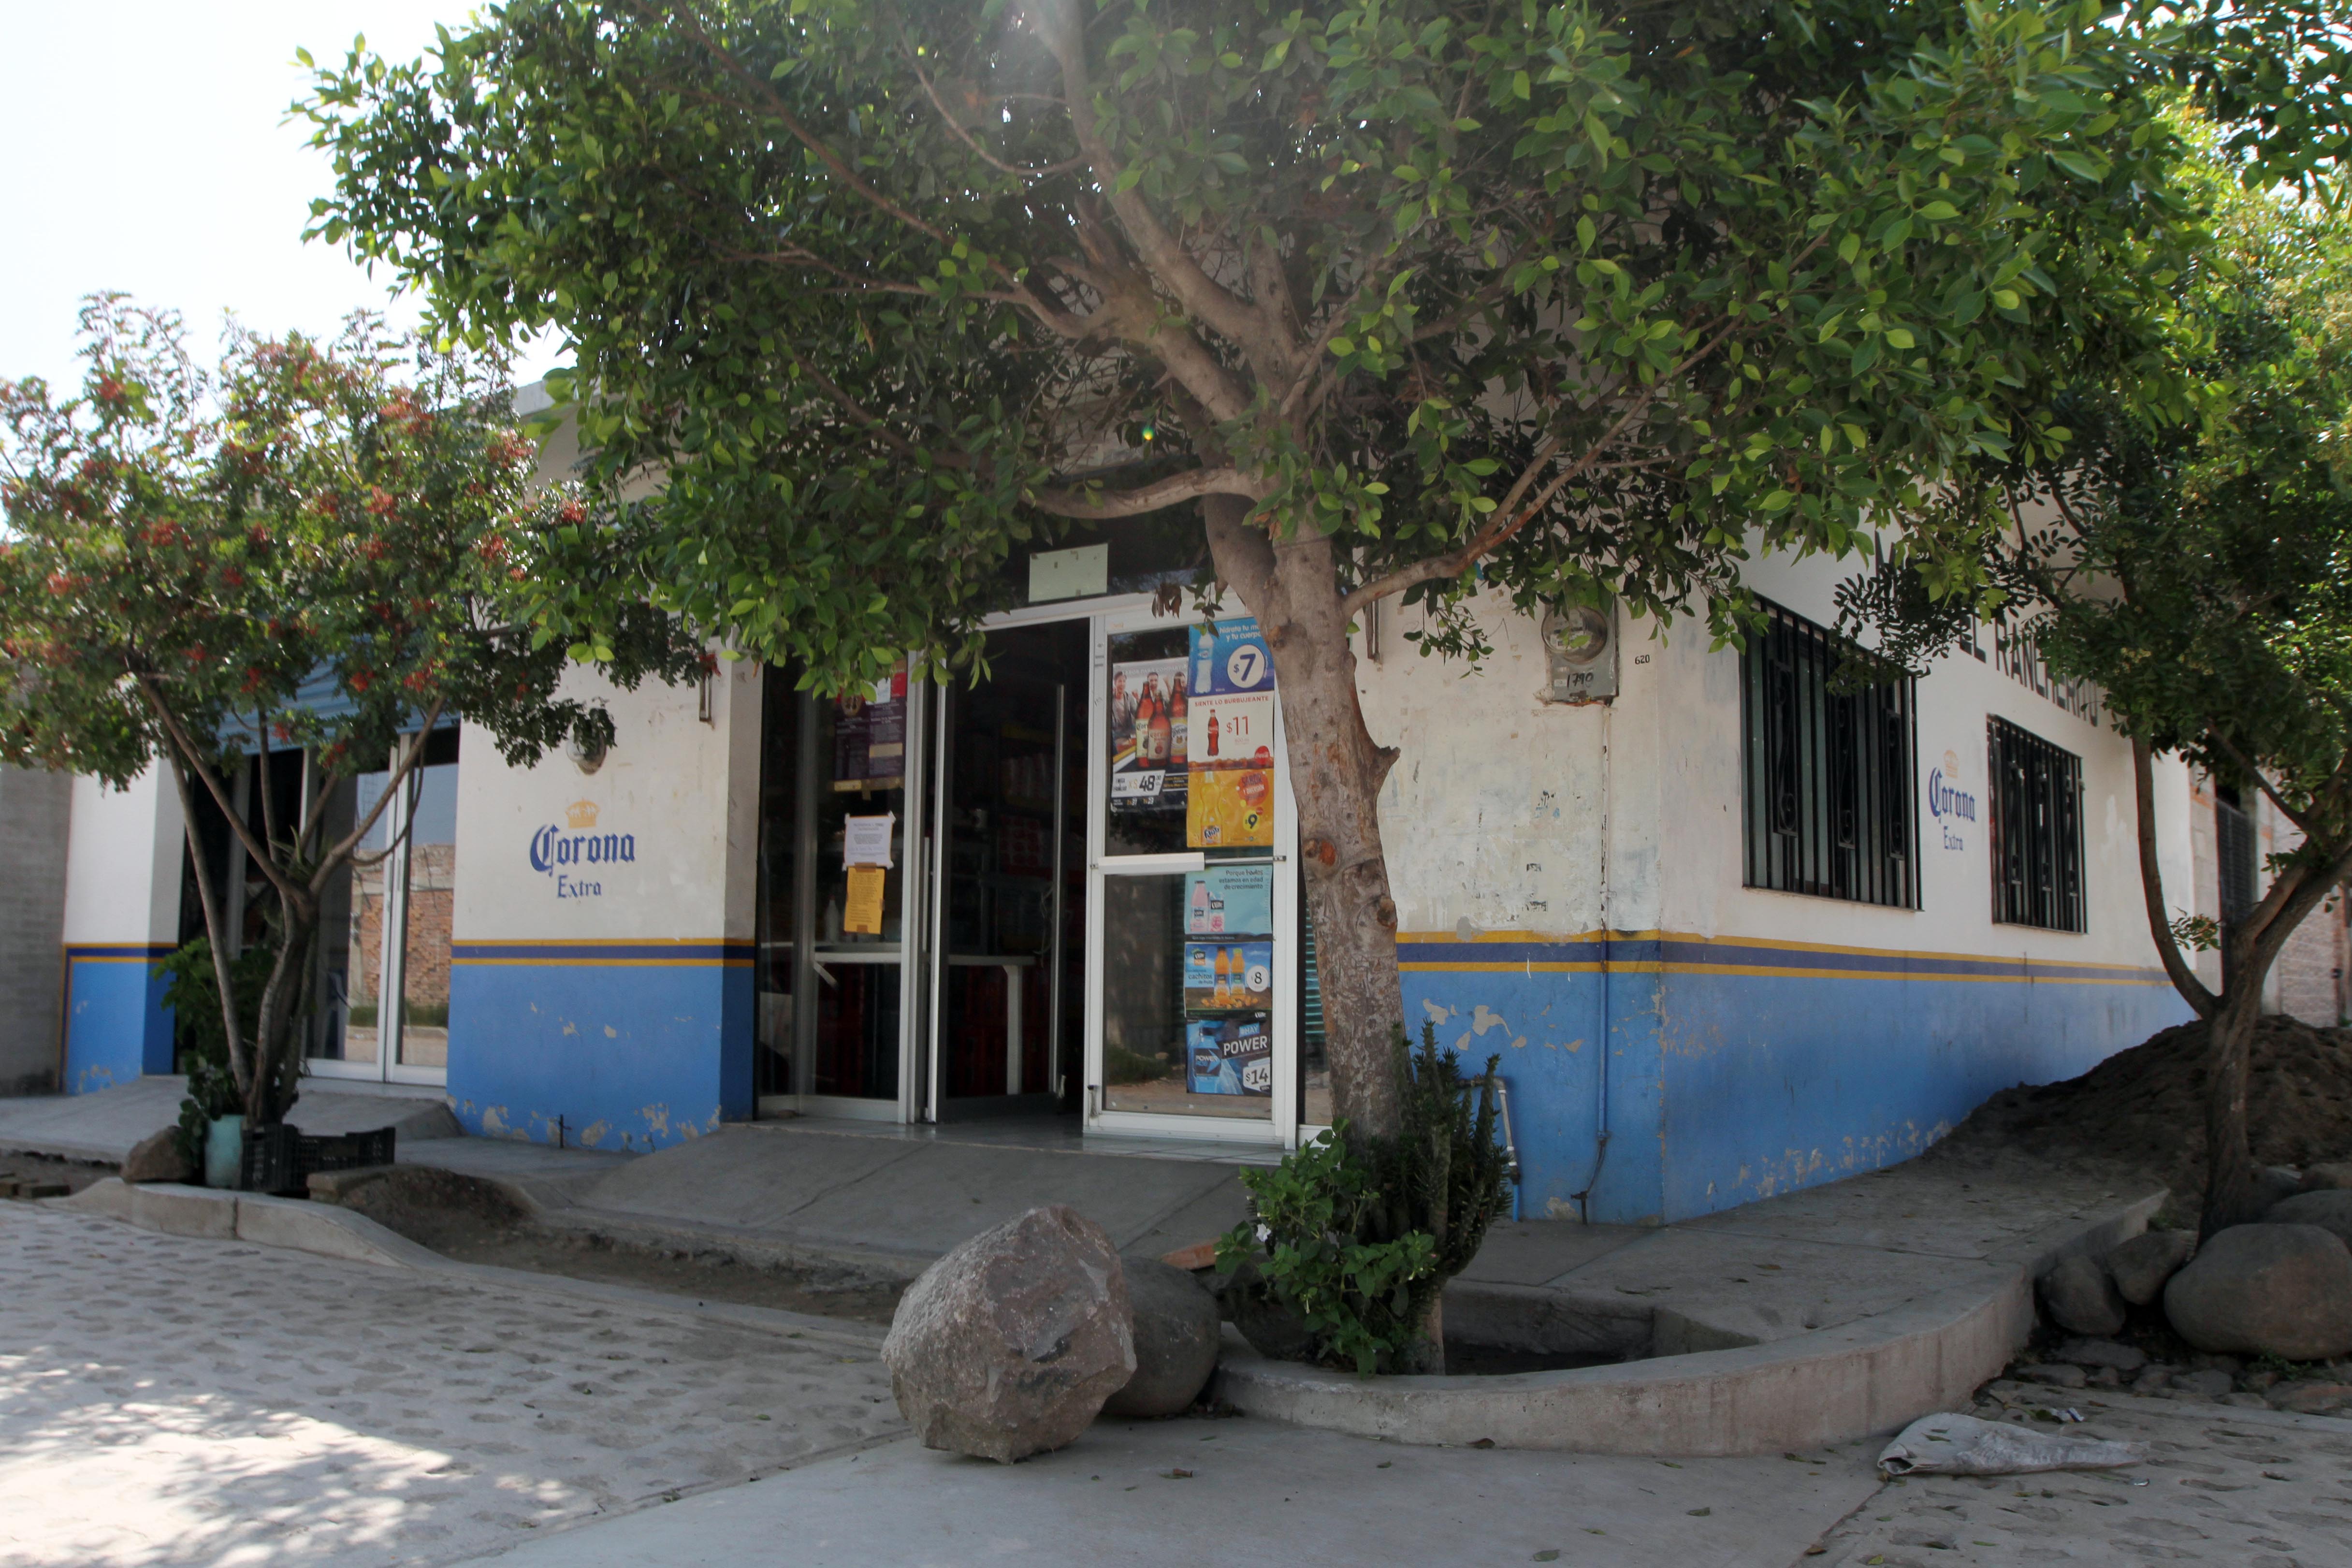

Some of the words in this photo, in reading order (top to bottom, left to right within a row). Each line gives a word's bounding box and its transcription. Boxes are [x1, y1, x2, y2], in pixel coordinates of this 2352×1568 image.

[1226, 634, 1231, 642] y
[1234, 653, 1256, 682] $7
[1635, 654, 1650, 665] 620
[1224, 696, 1269, 704] BURBUJEANTE
[1226, 715, 1249, 735] $11
[1929, 767, 1976, 823] Corona
[1943, 826, 1963, 851] Extra
[530, 823, 636, 876] Corona
[557, 875, 602, 898] Extra
[1223, 1035, 1267, 1056] POWER
[1246, 1068, 1268, 1085] $14
